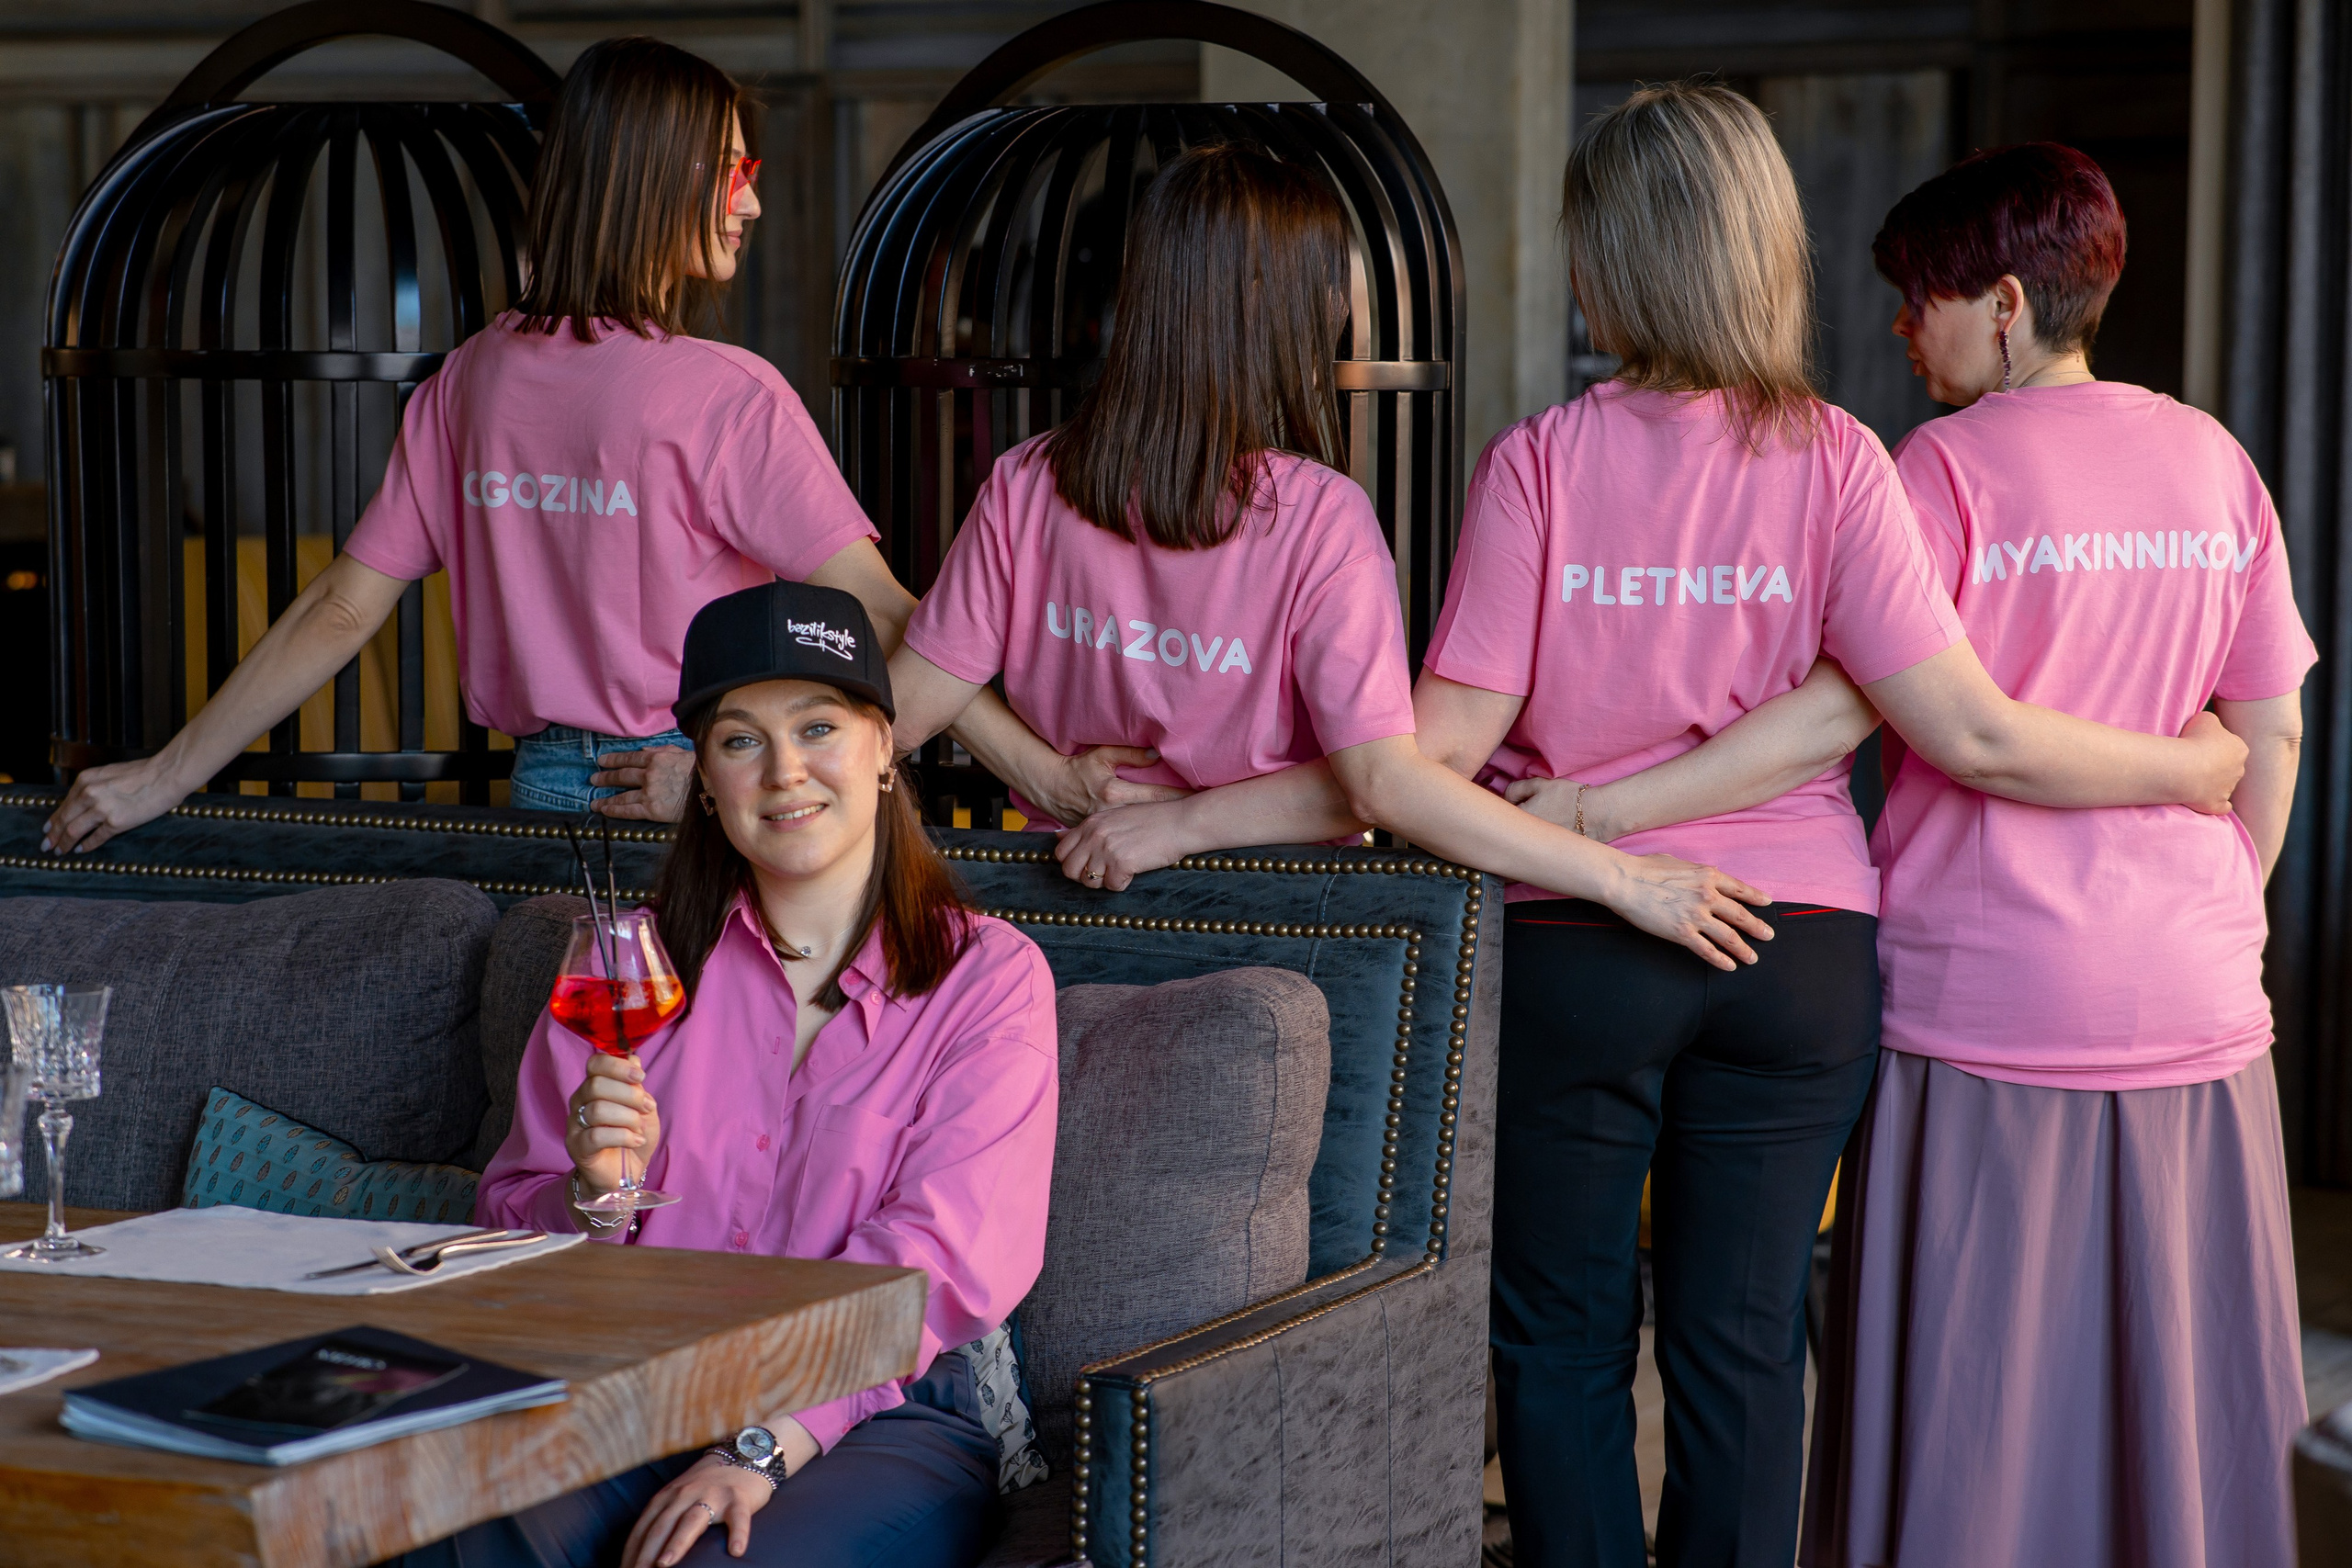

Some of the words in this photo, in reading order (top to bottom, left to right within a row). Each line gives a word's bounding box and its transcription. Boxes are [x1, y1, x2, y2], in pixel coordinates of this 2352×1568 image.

[1562, 564, 1793, 606] PLETNEVA
[1972, 530, 2258, 585] MYAKINNIKOV
[1046, 601, 1252, 674] URAZOVA
